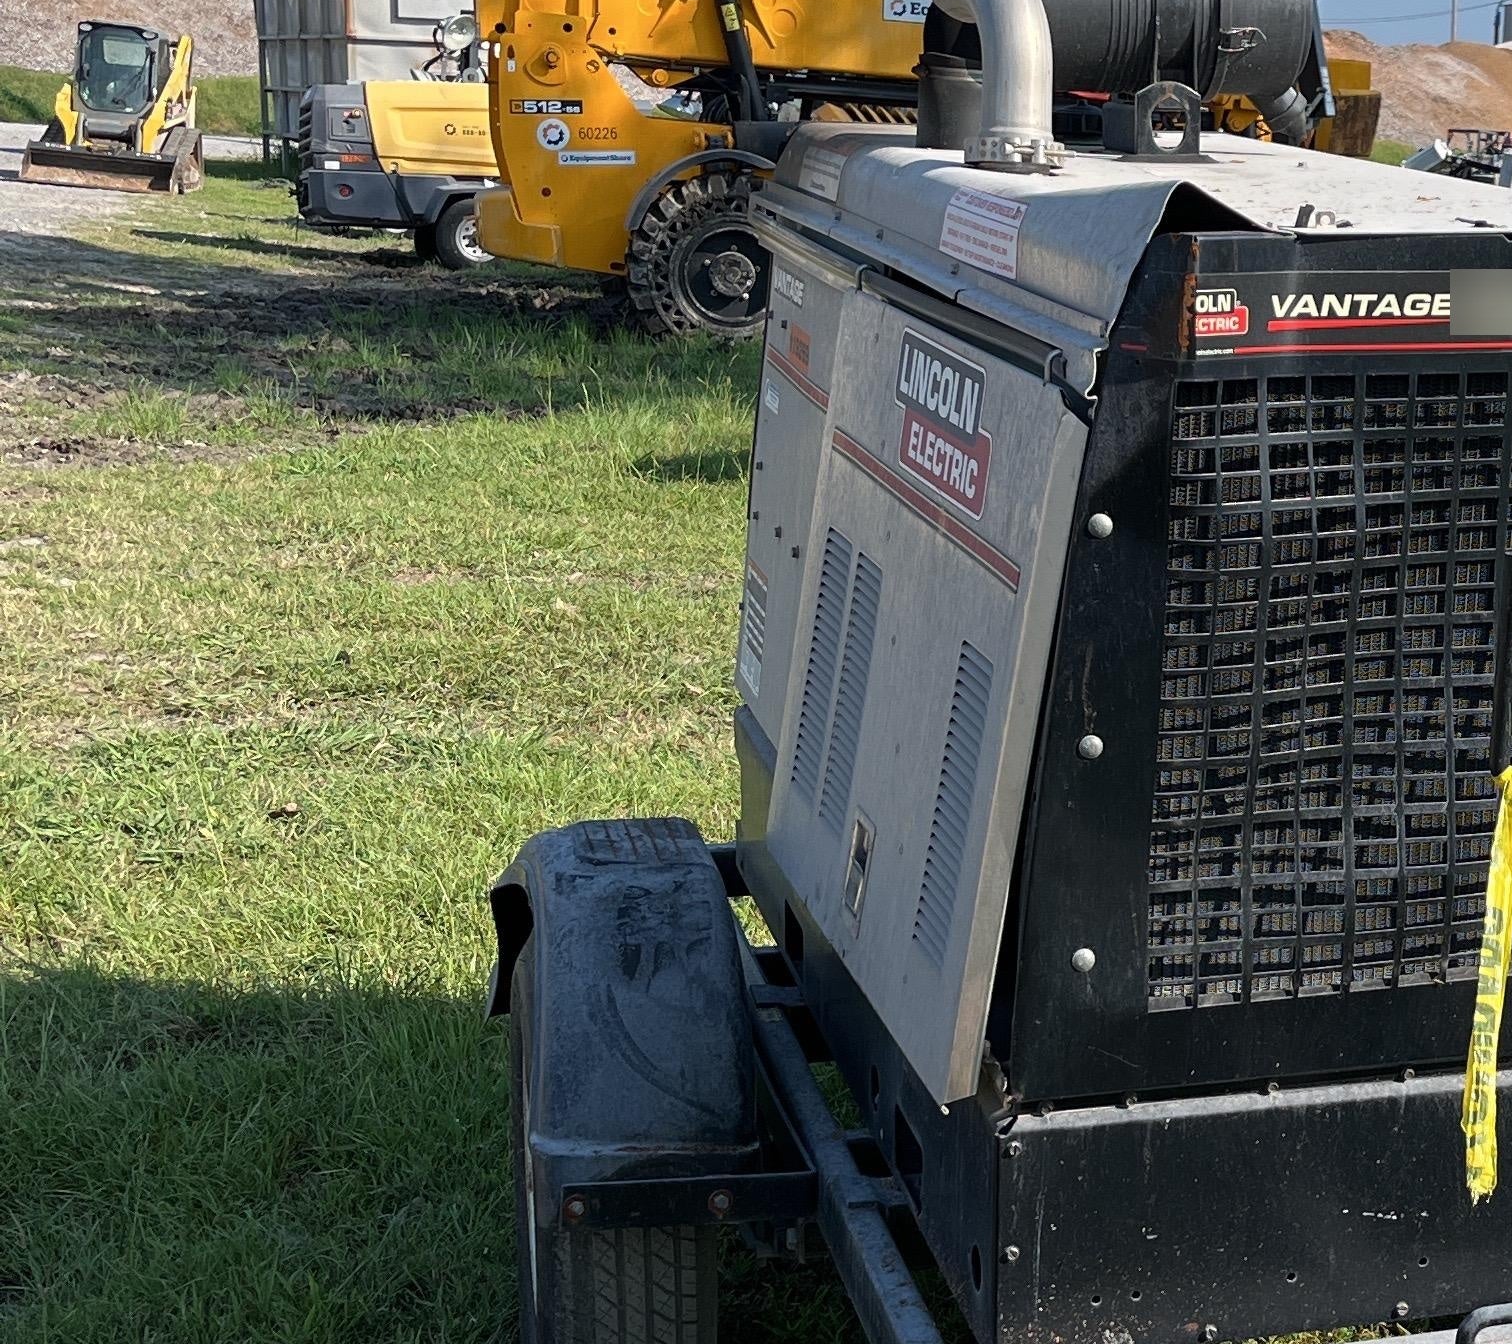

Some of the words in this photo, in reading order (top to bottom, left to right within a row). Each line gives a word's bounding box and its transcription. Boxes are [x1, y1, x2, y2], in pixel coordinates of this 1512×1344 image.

[578, 127, 618, 140] 60226
[1271, 293, 1450, 318] VANTAGE
[899, 344, 980, 434] LINCOLN
[908, 420, 979, 500] ELECTRIC
